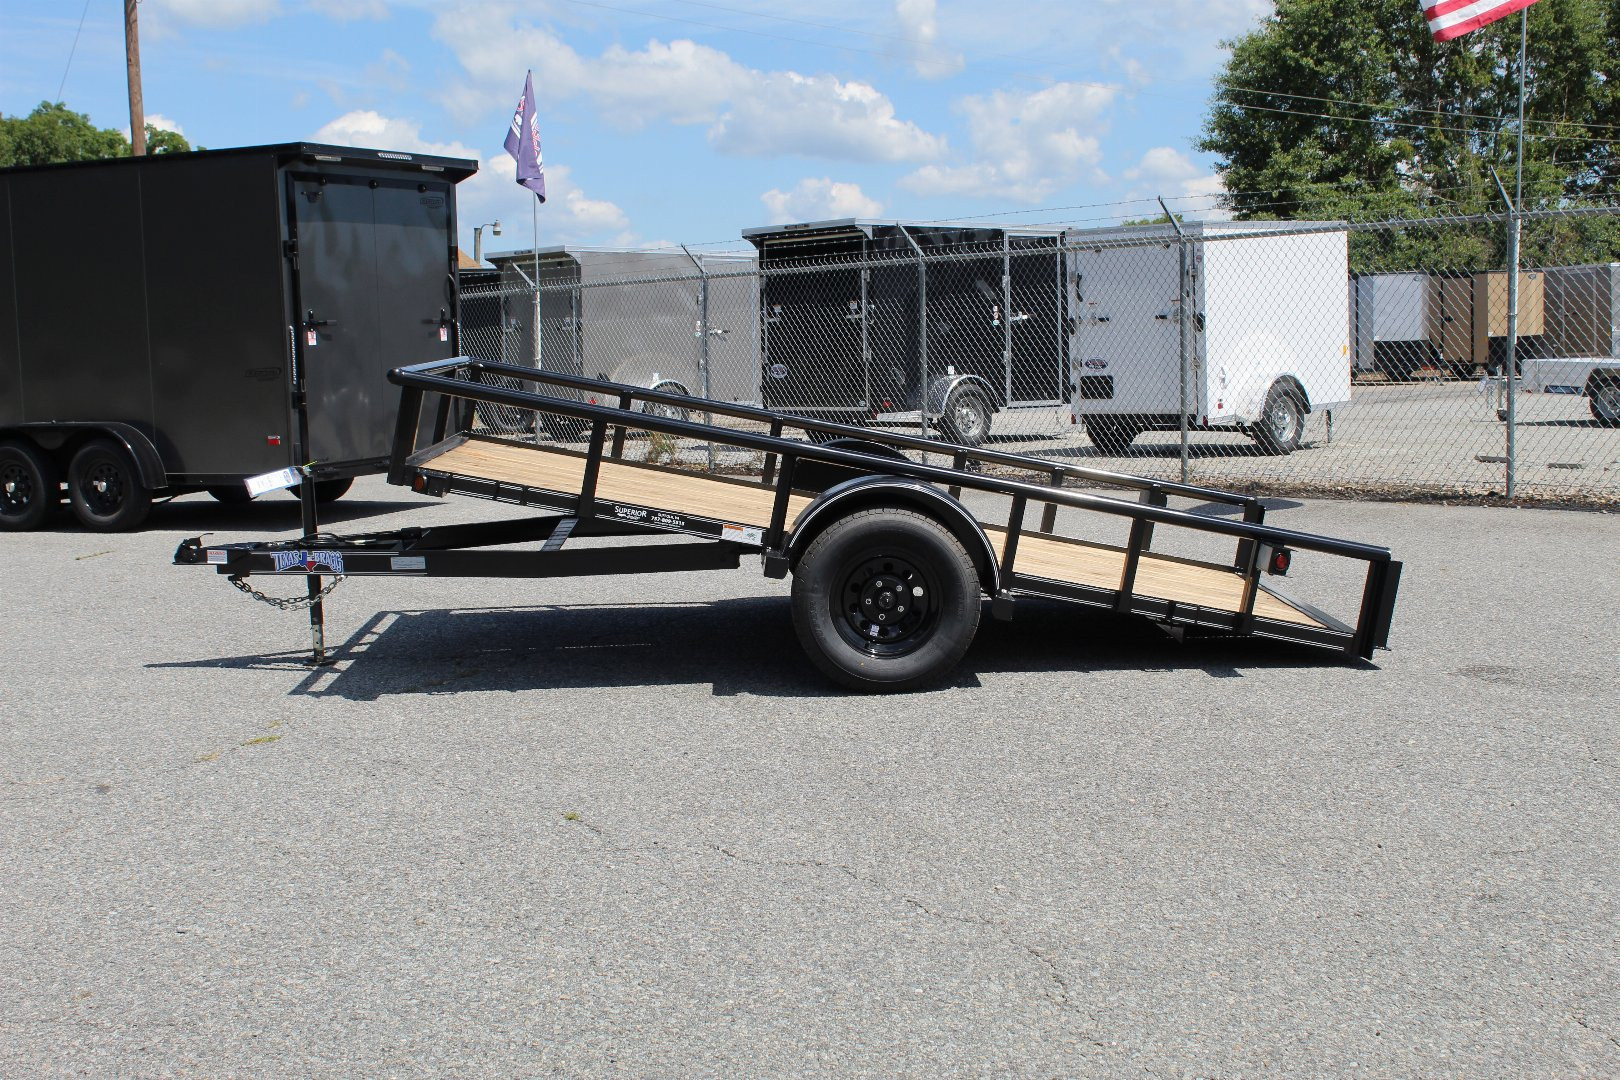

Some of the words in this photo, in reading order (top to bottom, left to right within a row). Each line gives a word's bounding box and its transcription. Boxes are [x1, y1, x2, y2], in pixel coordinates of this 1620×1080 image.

[615, 506, 647, 518] SUPERIOR
[270, 551, 301, 572] TEXAS
[312, 551, 343, 573] BRAGG
